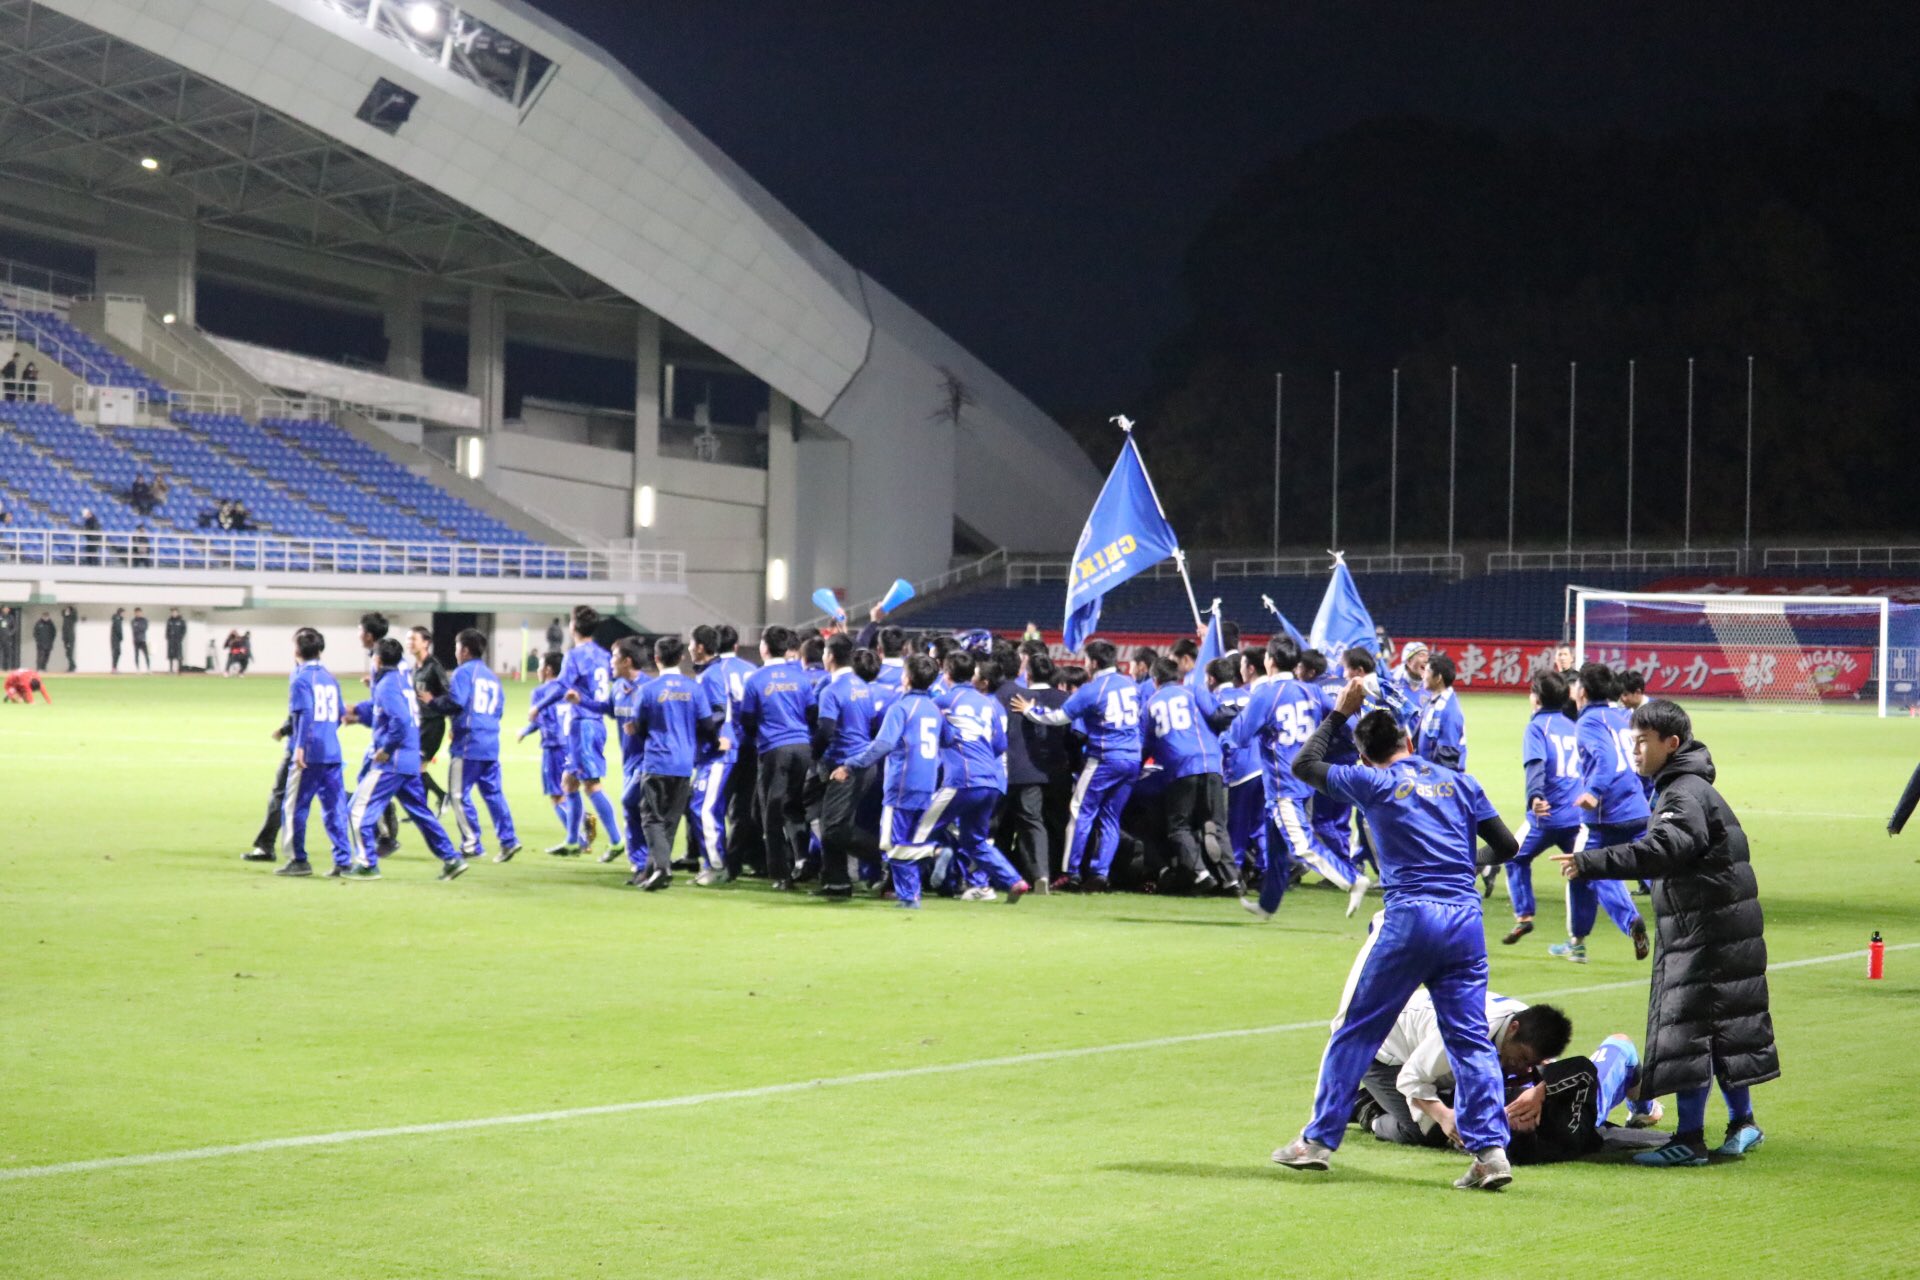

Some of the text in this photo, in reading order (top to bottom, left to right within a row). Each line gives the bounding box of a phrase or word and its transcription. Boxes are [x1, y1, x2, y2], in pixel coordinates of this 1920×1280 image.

[1797, 650, 1858, 673] HIGASHI
[314, 684, 339, 722] 83
[473, 678, 499, 715] 67
[594, 667, 609, 702] 3
[557, 703, 572, 736] 7
[1104, 686, 1139, 729] 45
[1150, 696, 1192, 738] 36
[1275, 701, 1317, 746] 35
[920, 717, 938, 760] 5
[1550, 734, 1580, 778] 12
